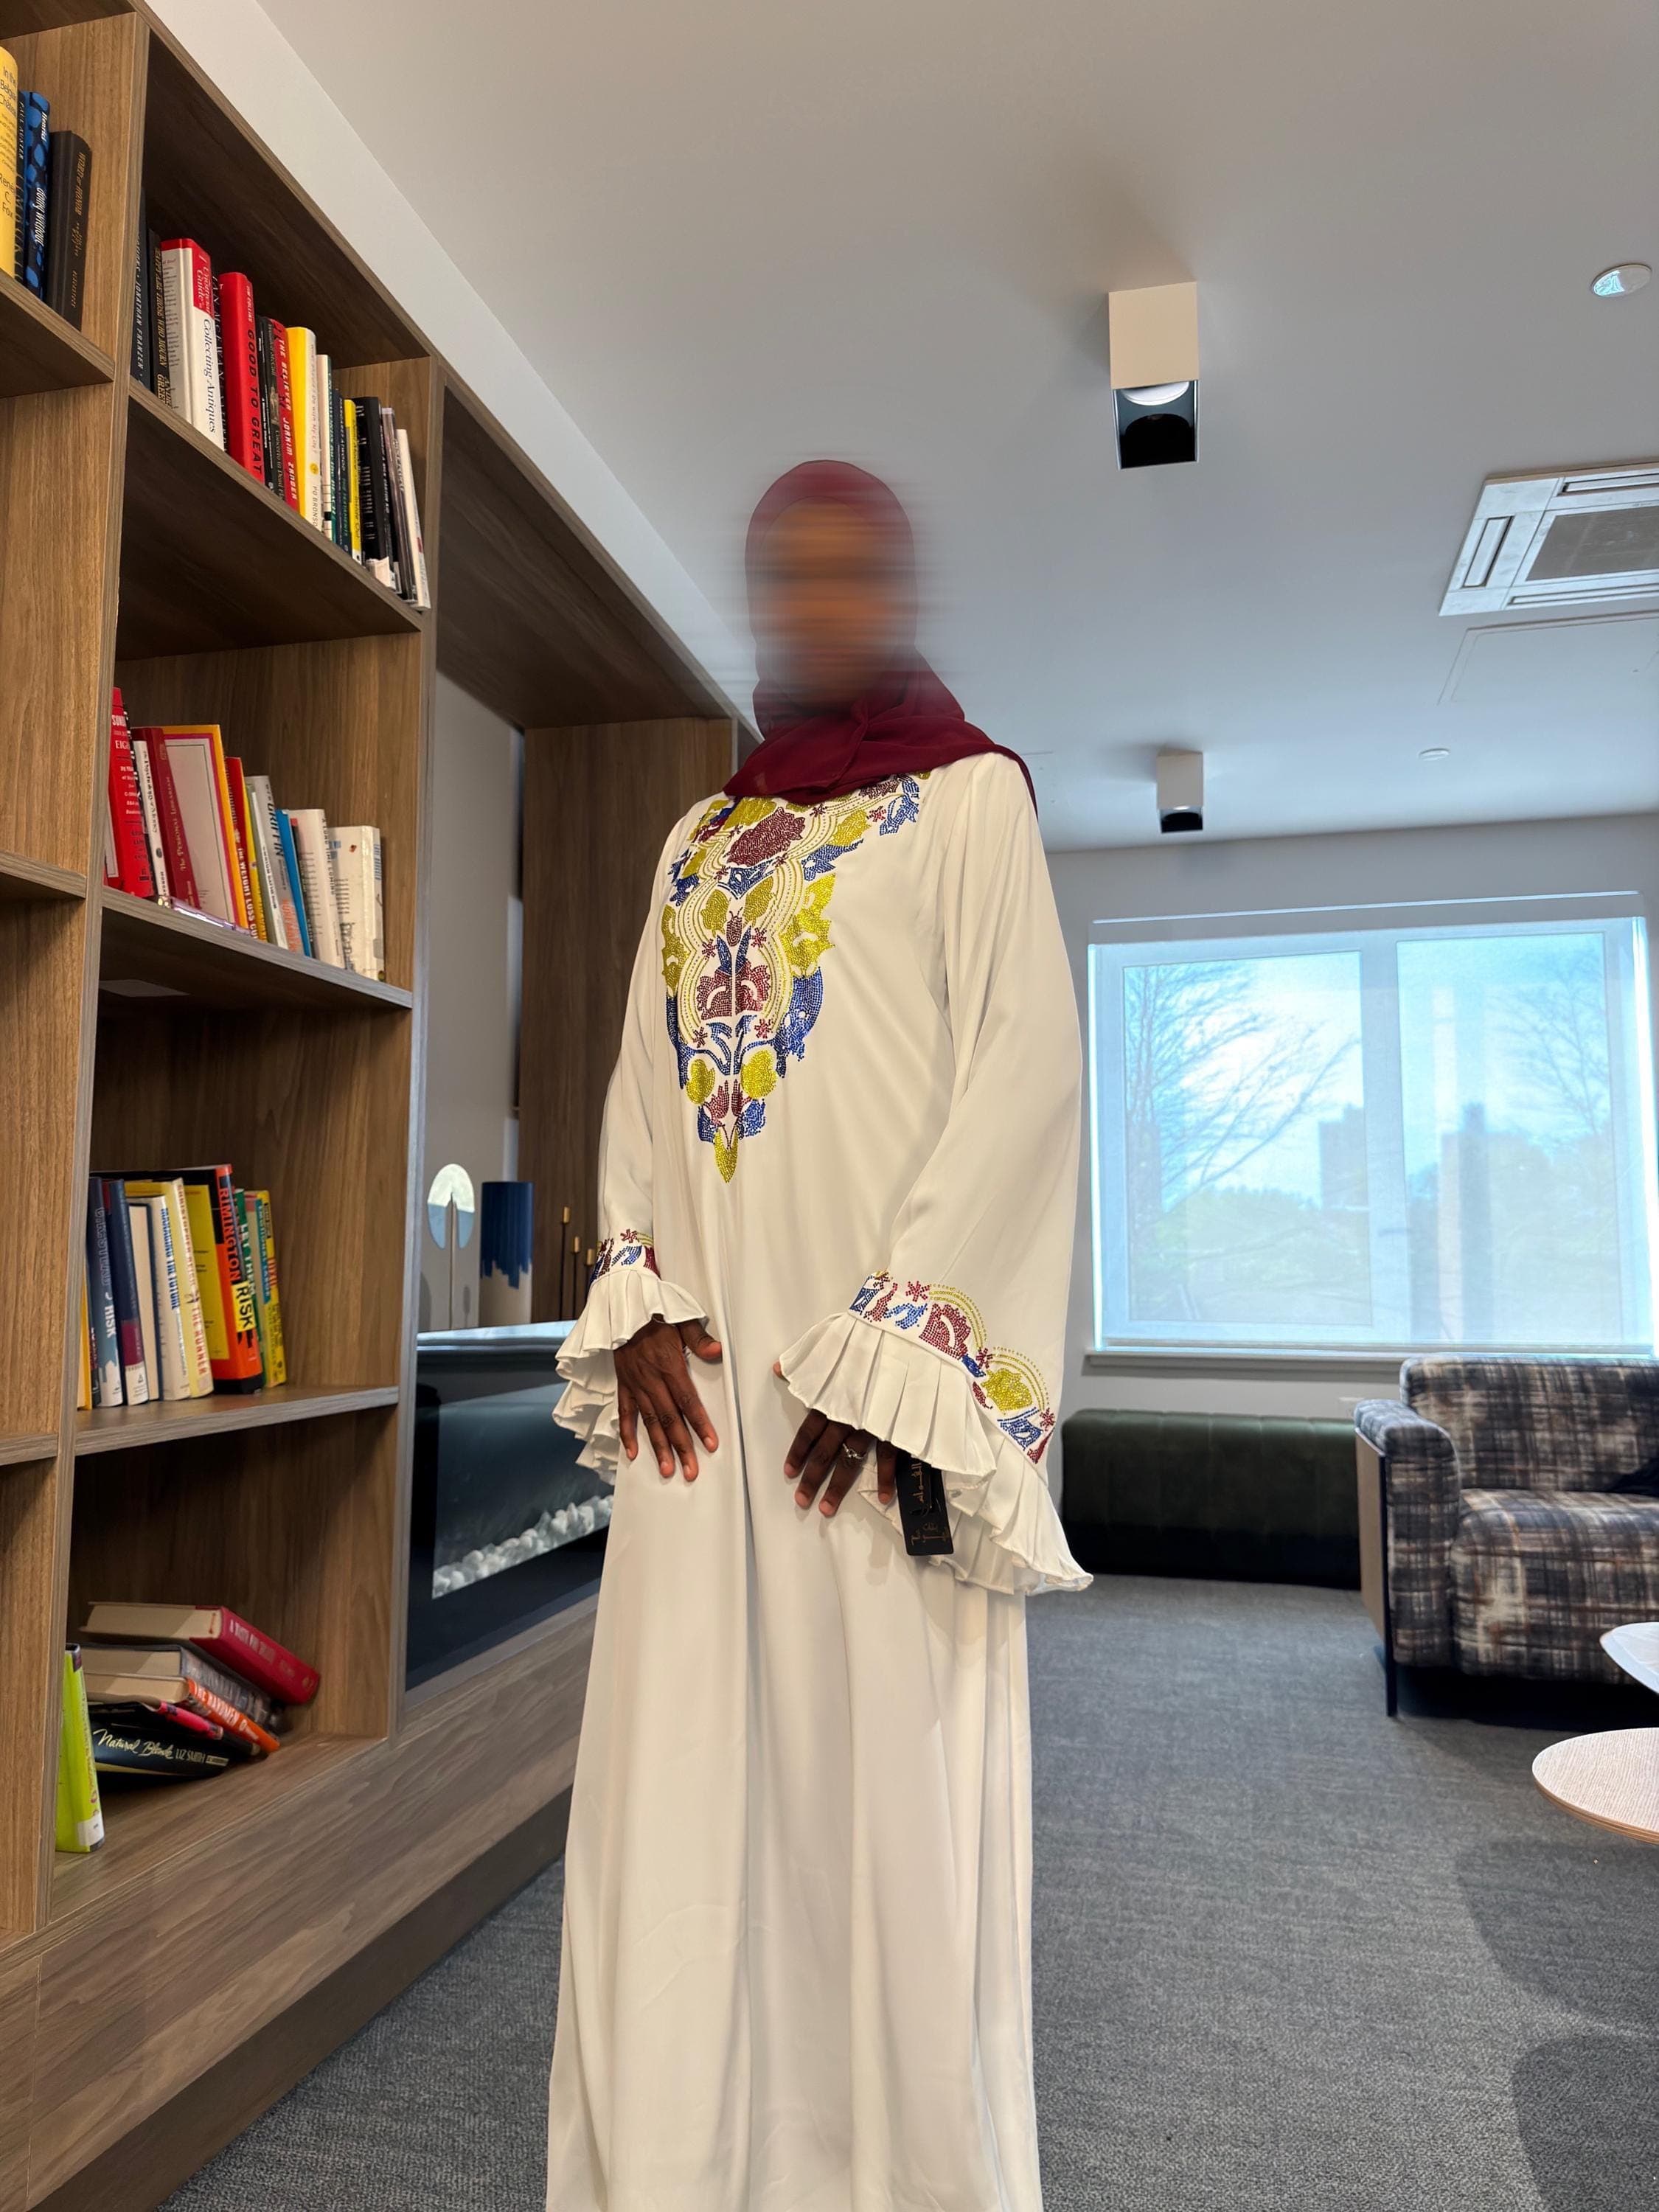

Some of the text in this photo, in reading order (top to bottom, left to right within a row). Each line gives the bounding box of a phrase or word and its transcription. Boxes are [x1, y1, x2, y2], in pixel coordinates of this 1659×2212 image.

[76, 152, 86, 178] WORD
[32, 187, 47, 248] doing without
[74, 184, 83, 216] HONOR
[156, 291, 164, 317] THOSE
[136, 327, 144, 370] FRANZEN
[158, 319, 167, 341] WHO
[158, 341, 168, 368] MOURN
[204, 319, 216, 434] Collecting Antiques
[247, 329, 262, 475] GOOD TO GREAT
[277, 338, 297, 500] THE BELIEVER JOAKIM ZANDER
[312, 485, 319, 496] PO
[268, 802, 285, 857] GRIFFIN
[240, 862, 251, 897] WEIGHT
[245, 898, 256, 922] LOSS
[219, 1188, 242, 1282] RIMINGTON
[161, 1207, 181, 1311] MANAGING THE FUTURE
[105, 1304, 117, 1339] RISK
[235, 1286, 253, 1329] RISK
[192, 1307, 207, 1376] THE RUNNER
[94, 1728, 141, 1754] Natural
[138, 1741, 175, 1760] Blonde
[175, 1748, 187, 1760] LIZ
[187, 1750, 206, 1764] SMITH
